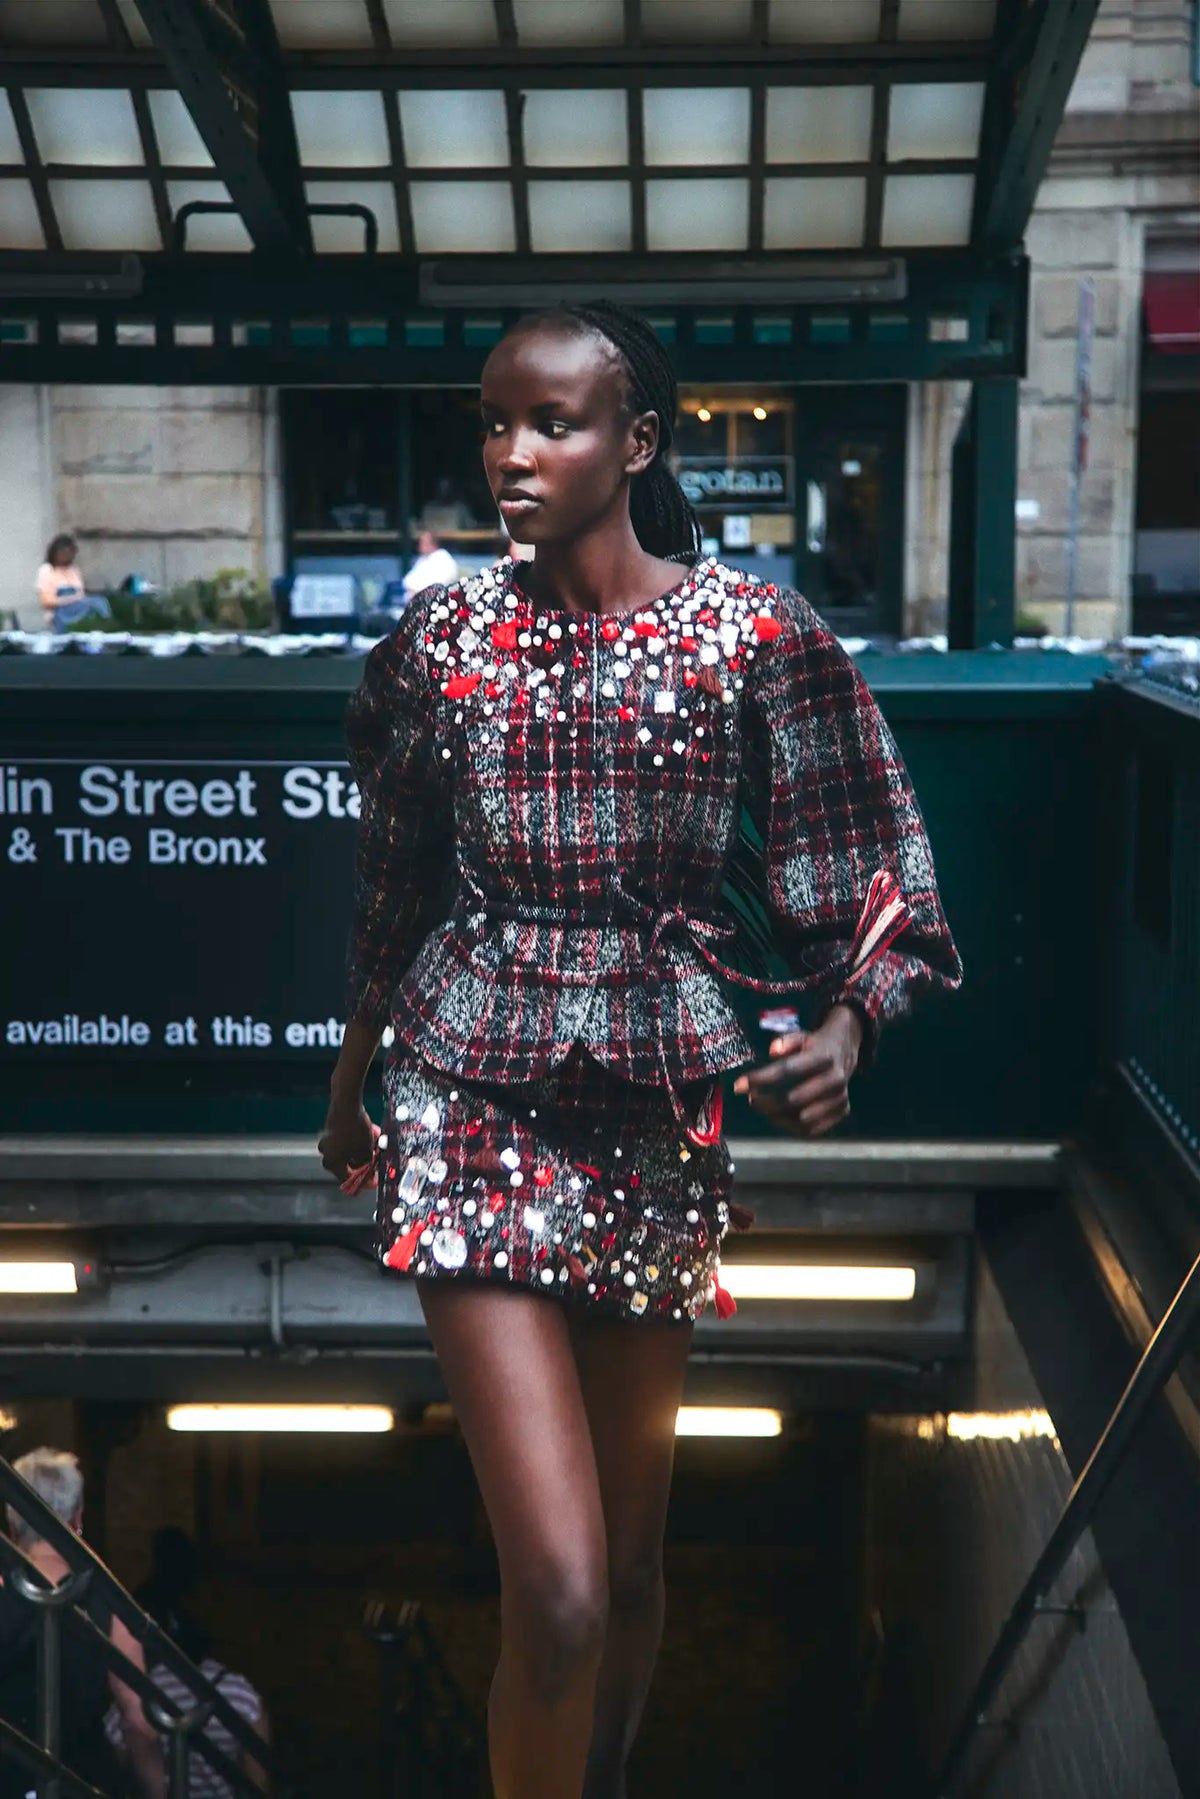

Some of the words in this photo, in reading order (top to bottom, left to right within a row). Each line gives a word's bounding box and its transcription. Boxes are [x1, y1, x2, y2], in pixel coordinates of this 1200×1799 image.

[80, 766, 258, 817] Street
[8, 827, 37, 863] &
[55, 828, 132, 864] The
[149, 828, 267, 865] Bronx
[6, 1014, 151, 1045] available
[164, 1016, 198, 1045] at
[211, 1015, 272, 1047] this
